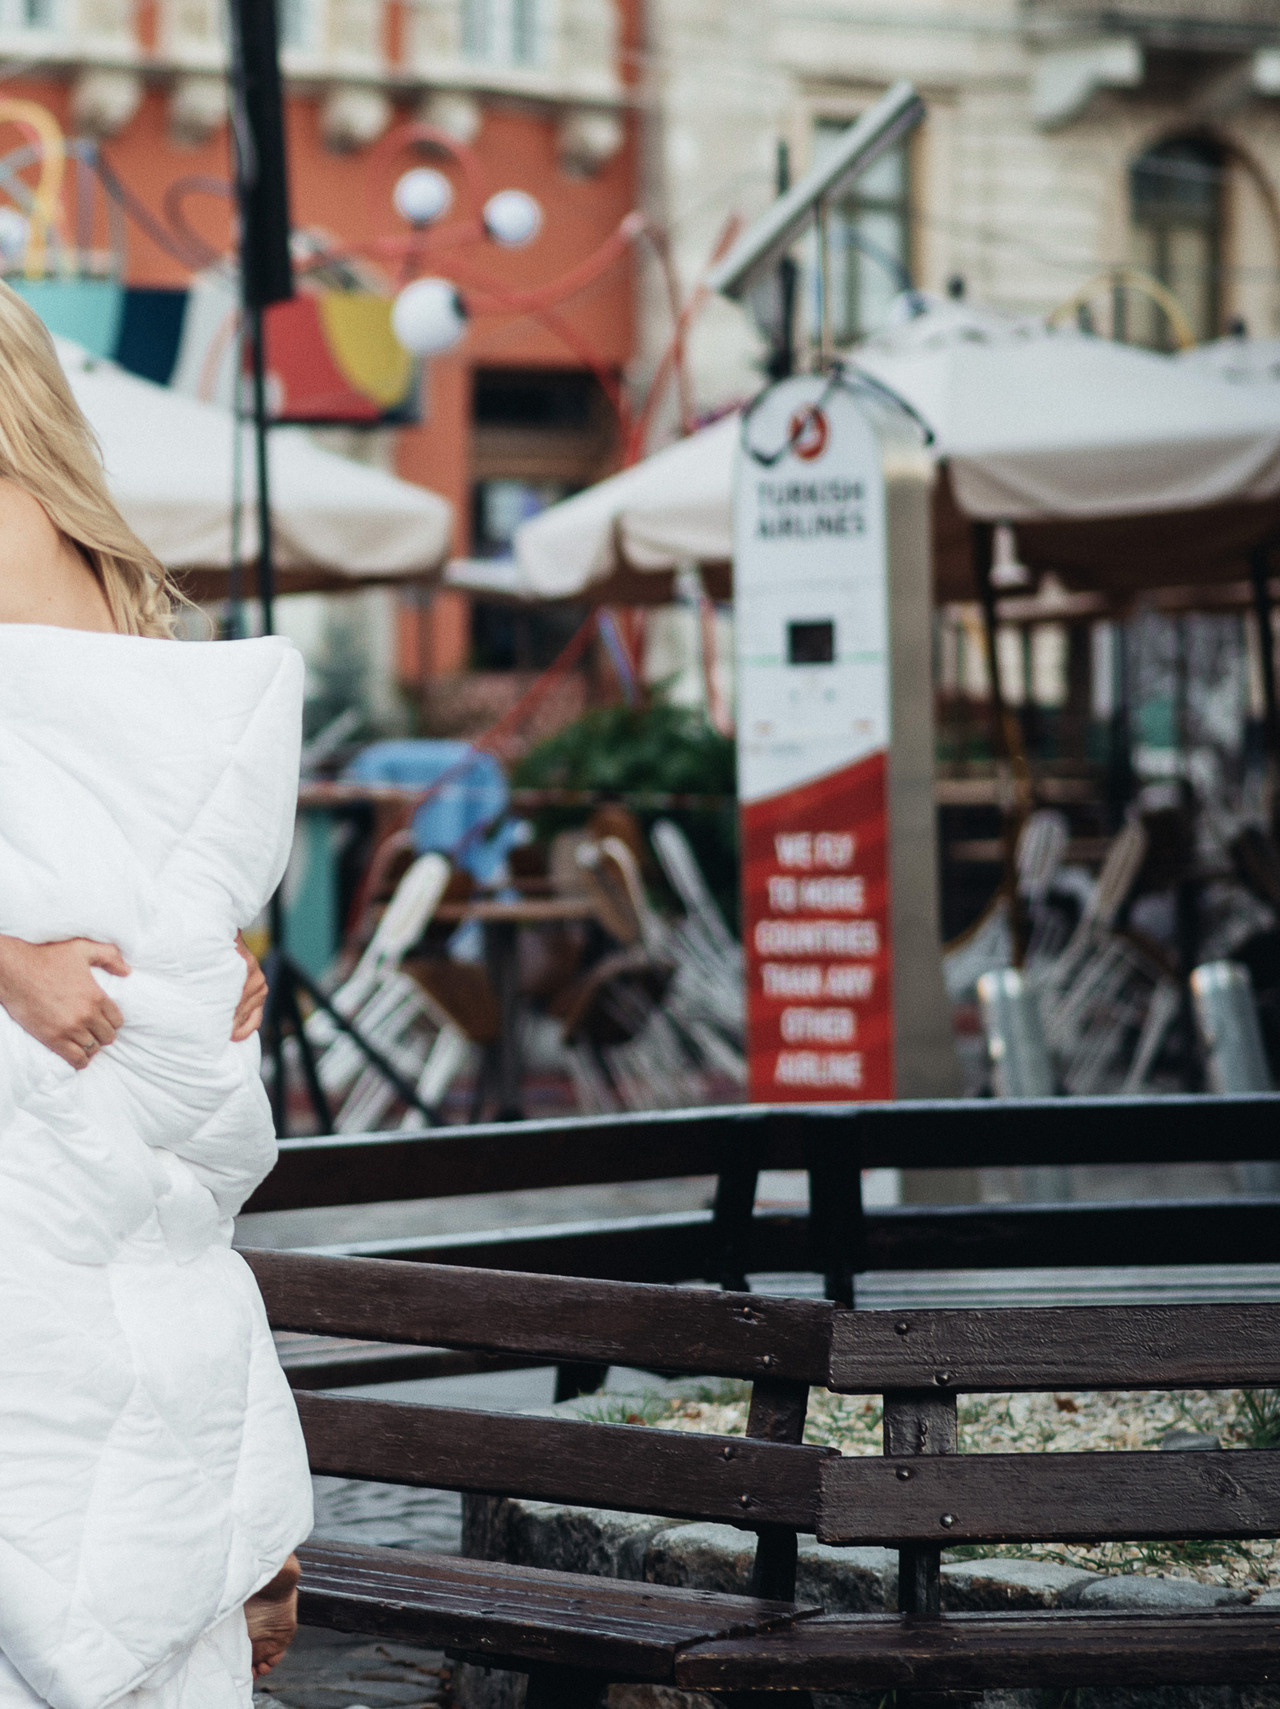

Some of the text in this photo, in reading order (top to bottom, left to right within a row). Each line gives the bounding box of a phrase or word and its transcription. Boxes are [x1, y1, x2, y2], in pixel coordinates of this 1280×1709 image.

[757, 480, 864, 504] TURKISH
[757, 515, 865, 538] AIRLINES
[774, 832, 811, 868] WE
[768, 876, 865, 913] TO MORE
[755, 920, 878, 956] COUNTRIES
[761, 962, 822, 997] THAN
[780, 1007, 856, 1042] OTHER
[775, 1052, 862, 1088] AIRLINE
